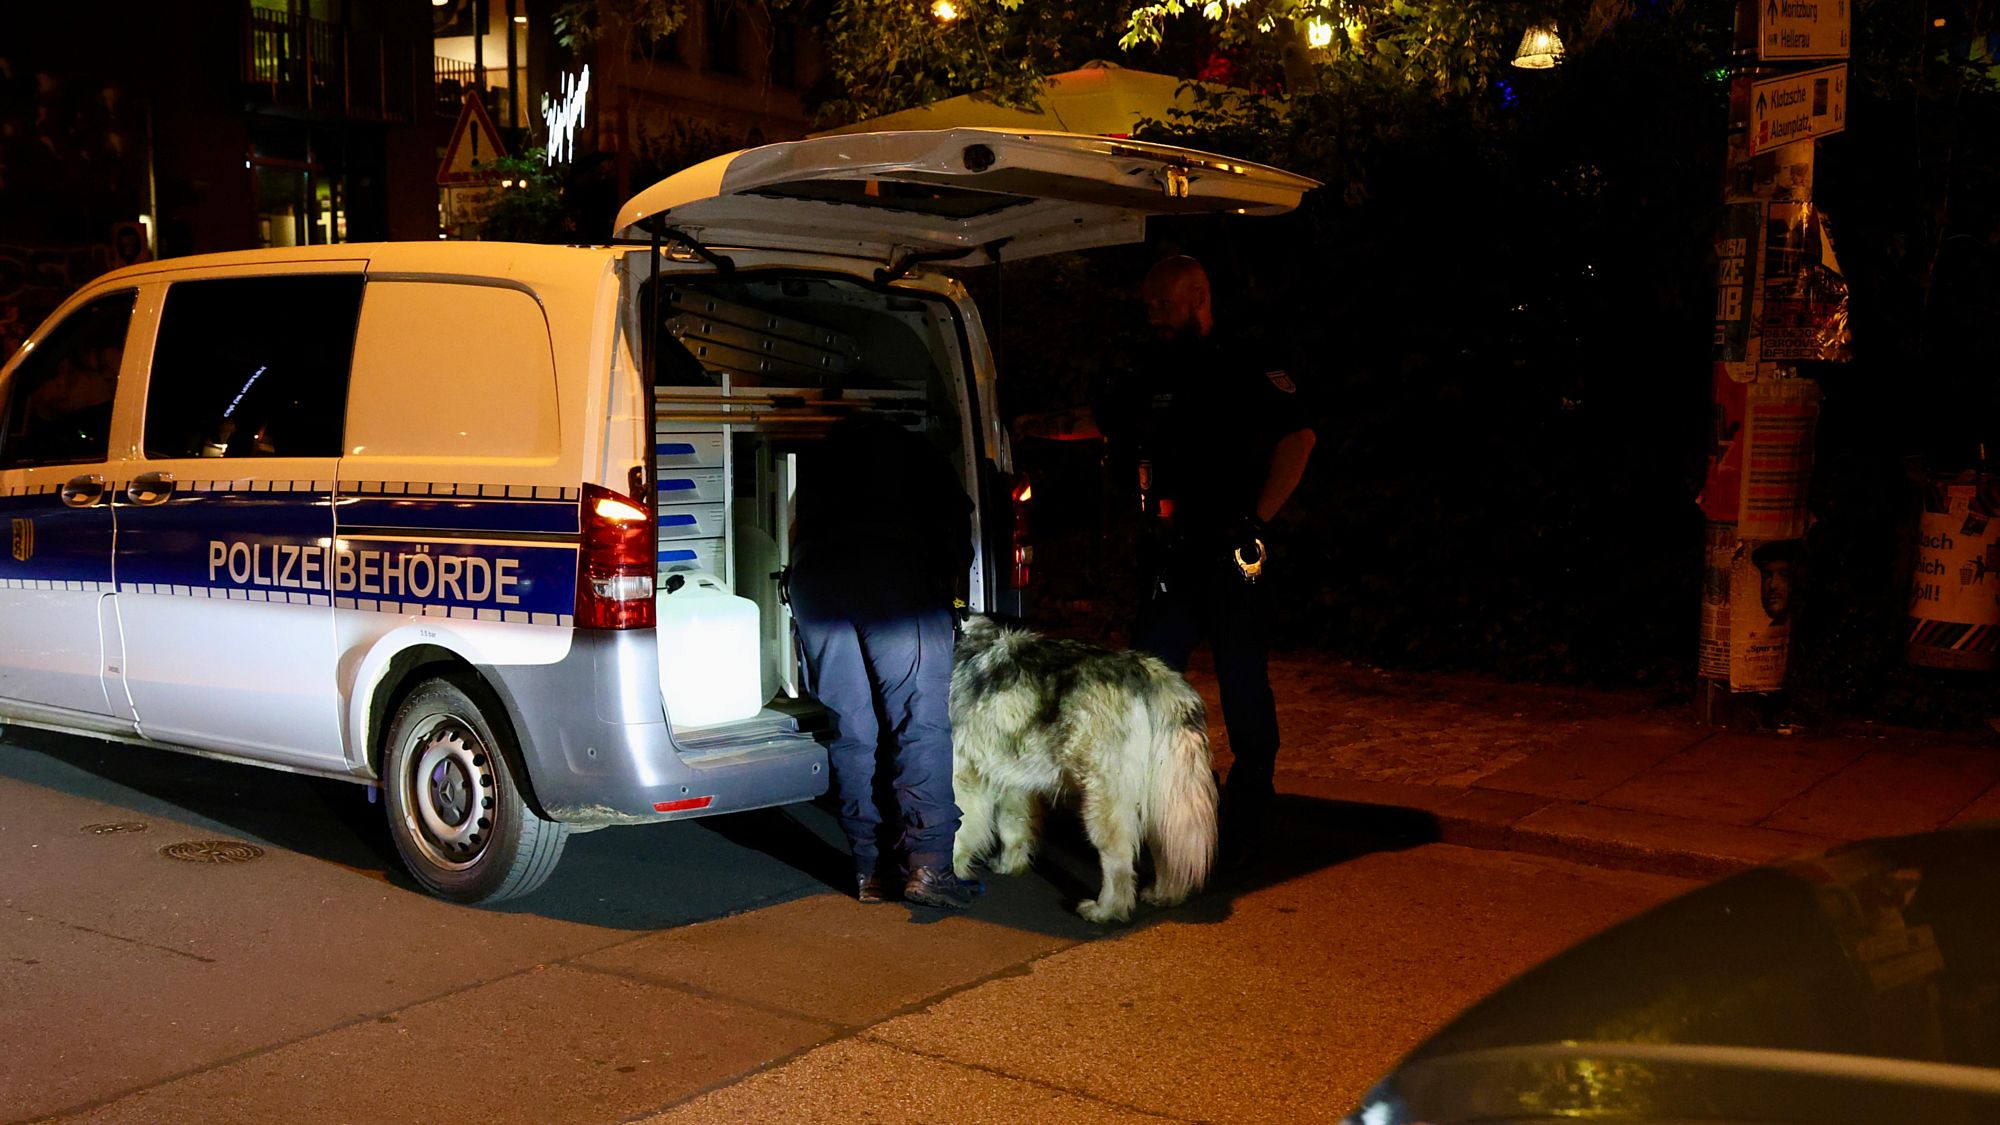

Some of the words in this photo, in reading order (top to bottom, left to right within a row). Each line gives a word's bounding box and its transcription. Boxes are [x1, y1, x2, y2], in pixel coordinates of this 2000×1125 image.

[1781, 0, 1818, 23] Moritzburg
[1781, 28, 1810, 48] Hellerau
[1771, 84, 1807, 110] Klotzsche
[1770, 113, 1809, 139] Alaunplatz
[208, 539, 521, 605] POLIZEIBEHÖRDE
